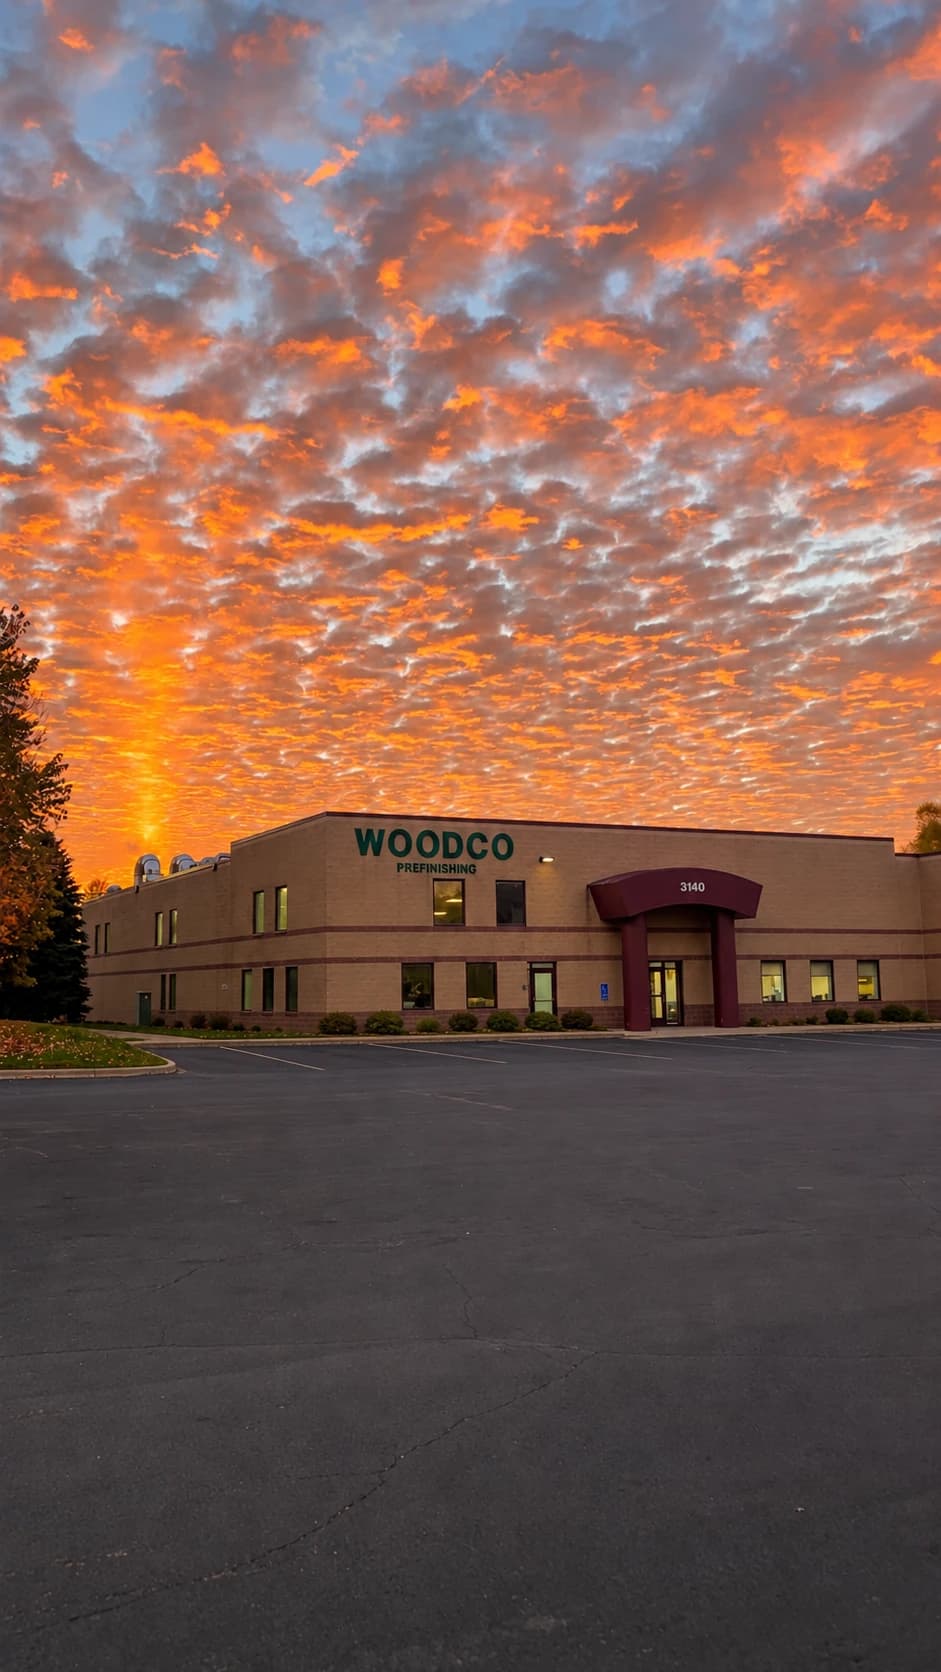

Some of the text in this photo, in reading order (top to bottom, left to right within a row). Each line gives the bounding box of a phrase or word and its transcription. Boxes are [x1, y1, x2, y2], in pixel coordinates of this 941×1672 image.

[354, 828, 514, 861] WOODCO
[397, 862, 477, 874] PREFINISHING
[680, 881, 705, 892] 3140
